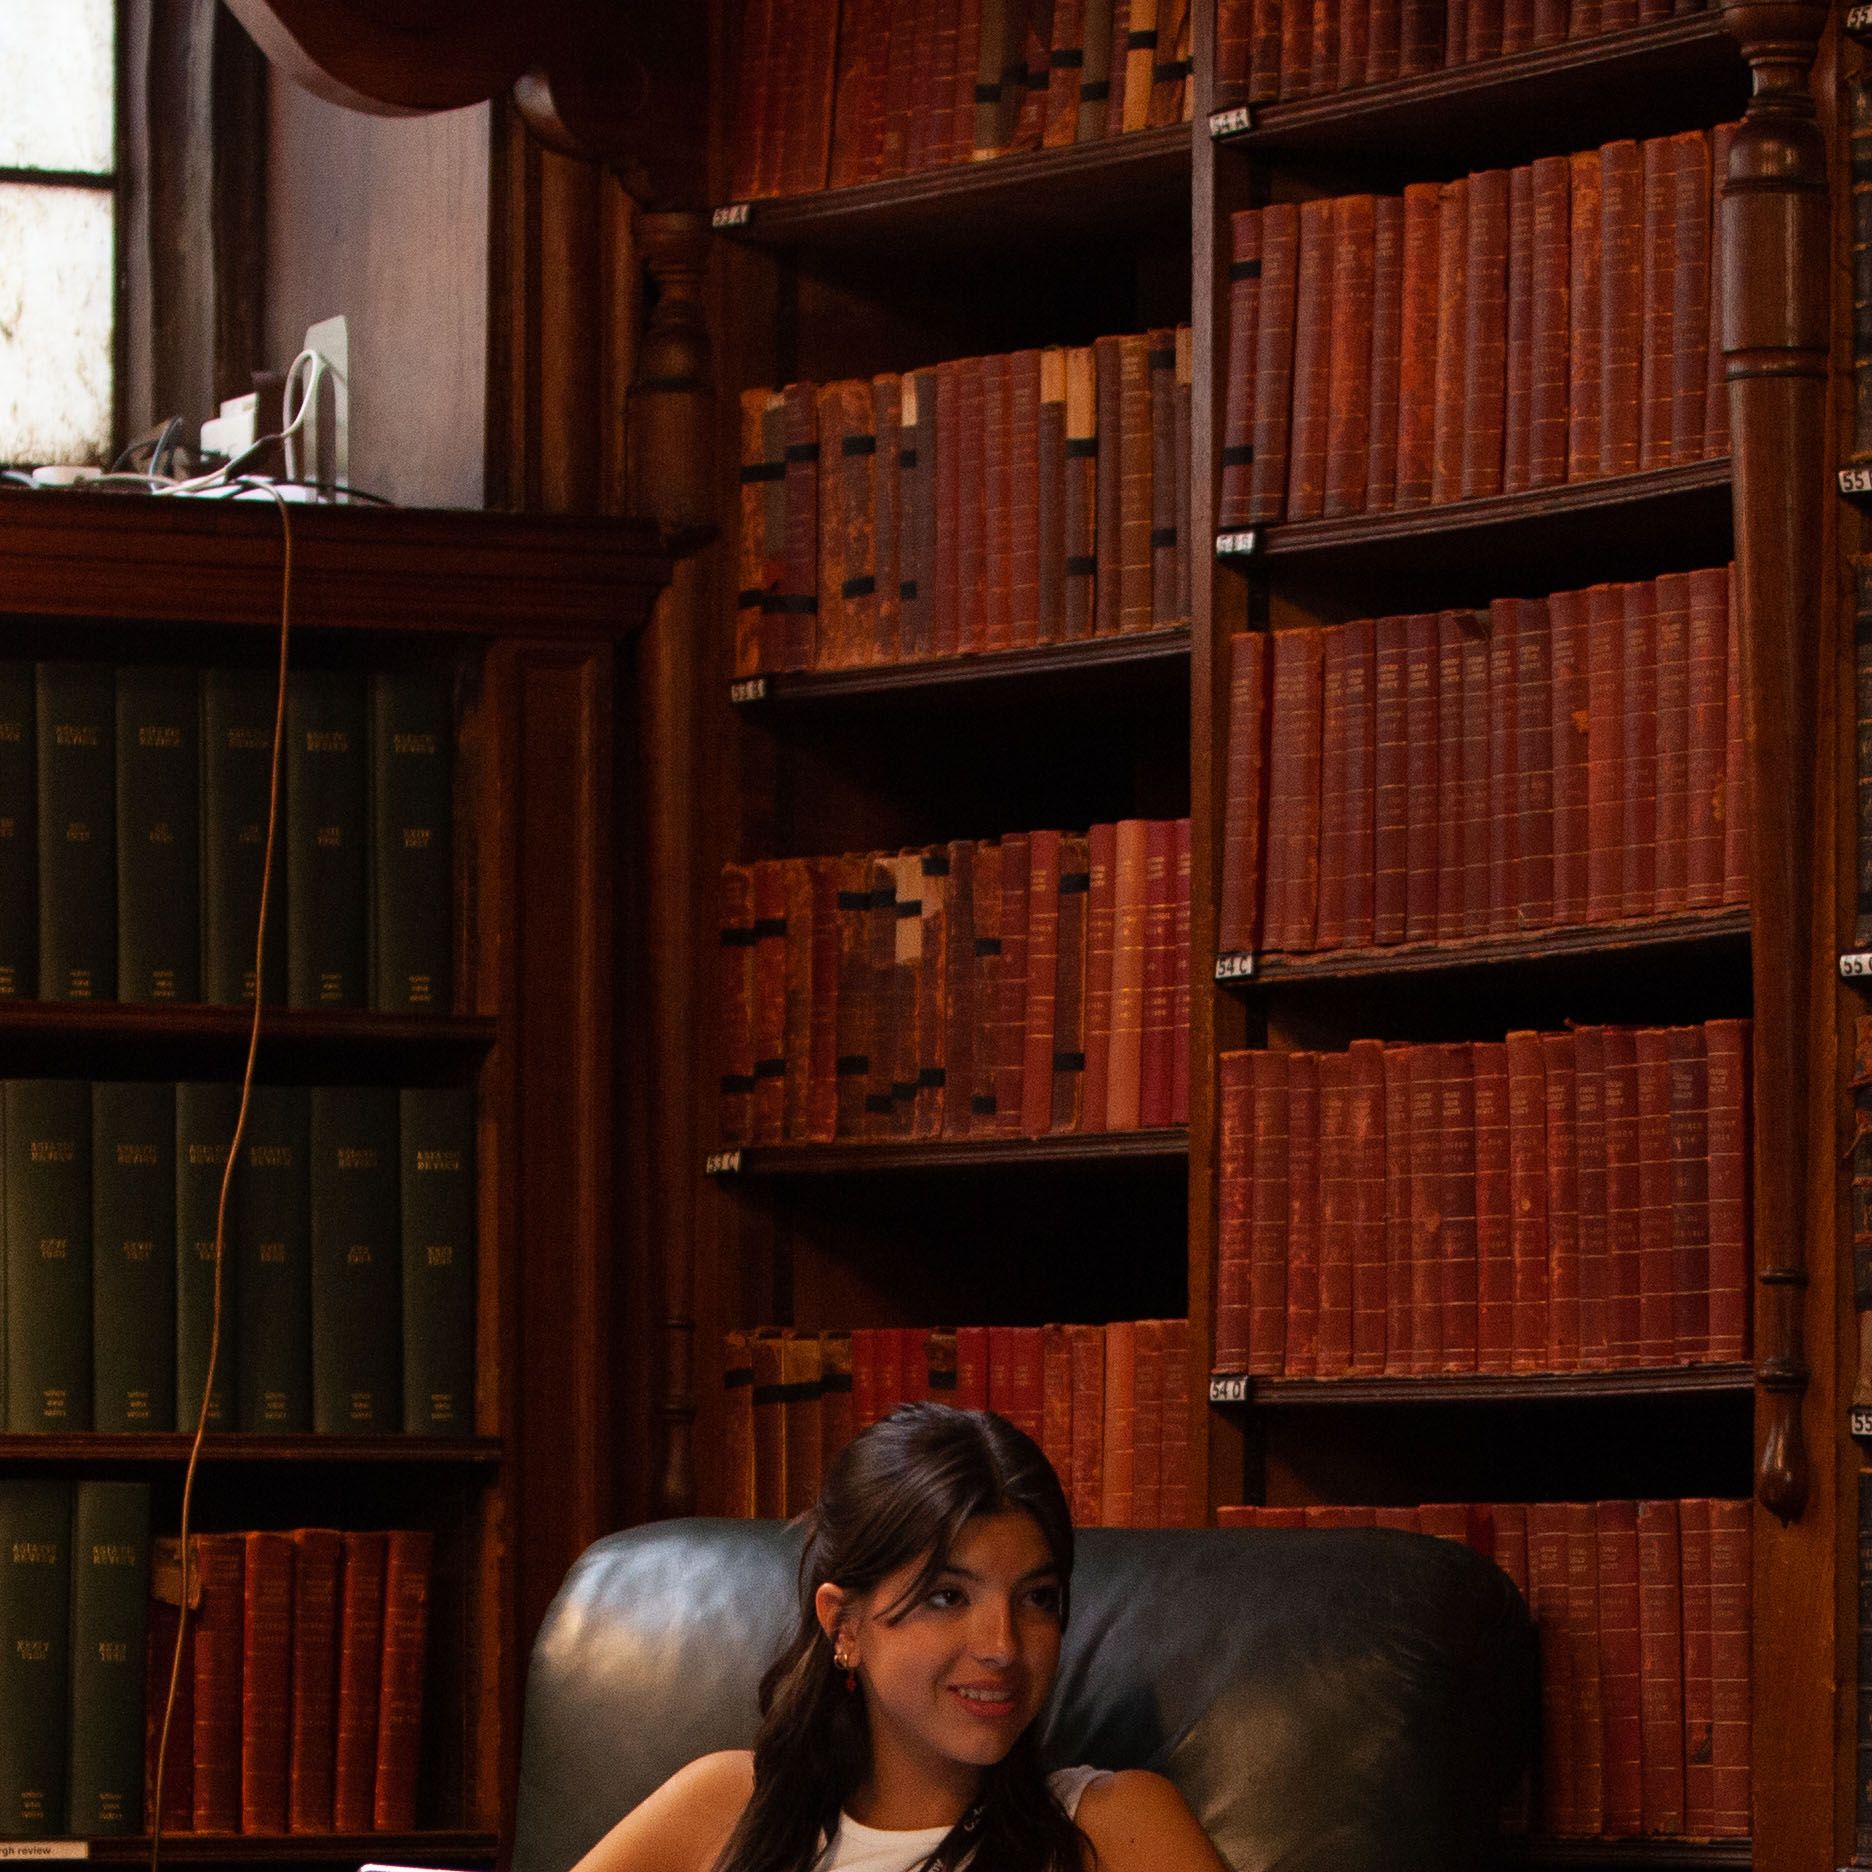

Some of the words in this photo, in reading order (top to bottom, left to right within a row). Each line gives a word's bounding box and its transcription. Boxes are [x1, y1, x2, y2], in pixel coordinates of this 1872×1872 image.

[1843, 472, 1864, 490] 55
[1217, 958, 1235, 976] 54
[1841, 957, 1862, 975] 55
[1212, 1382, 1227, 1398] 54
[1854, 1413, 1872, 1431] 55
[20, 1846, 53, 1857] review
